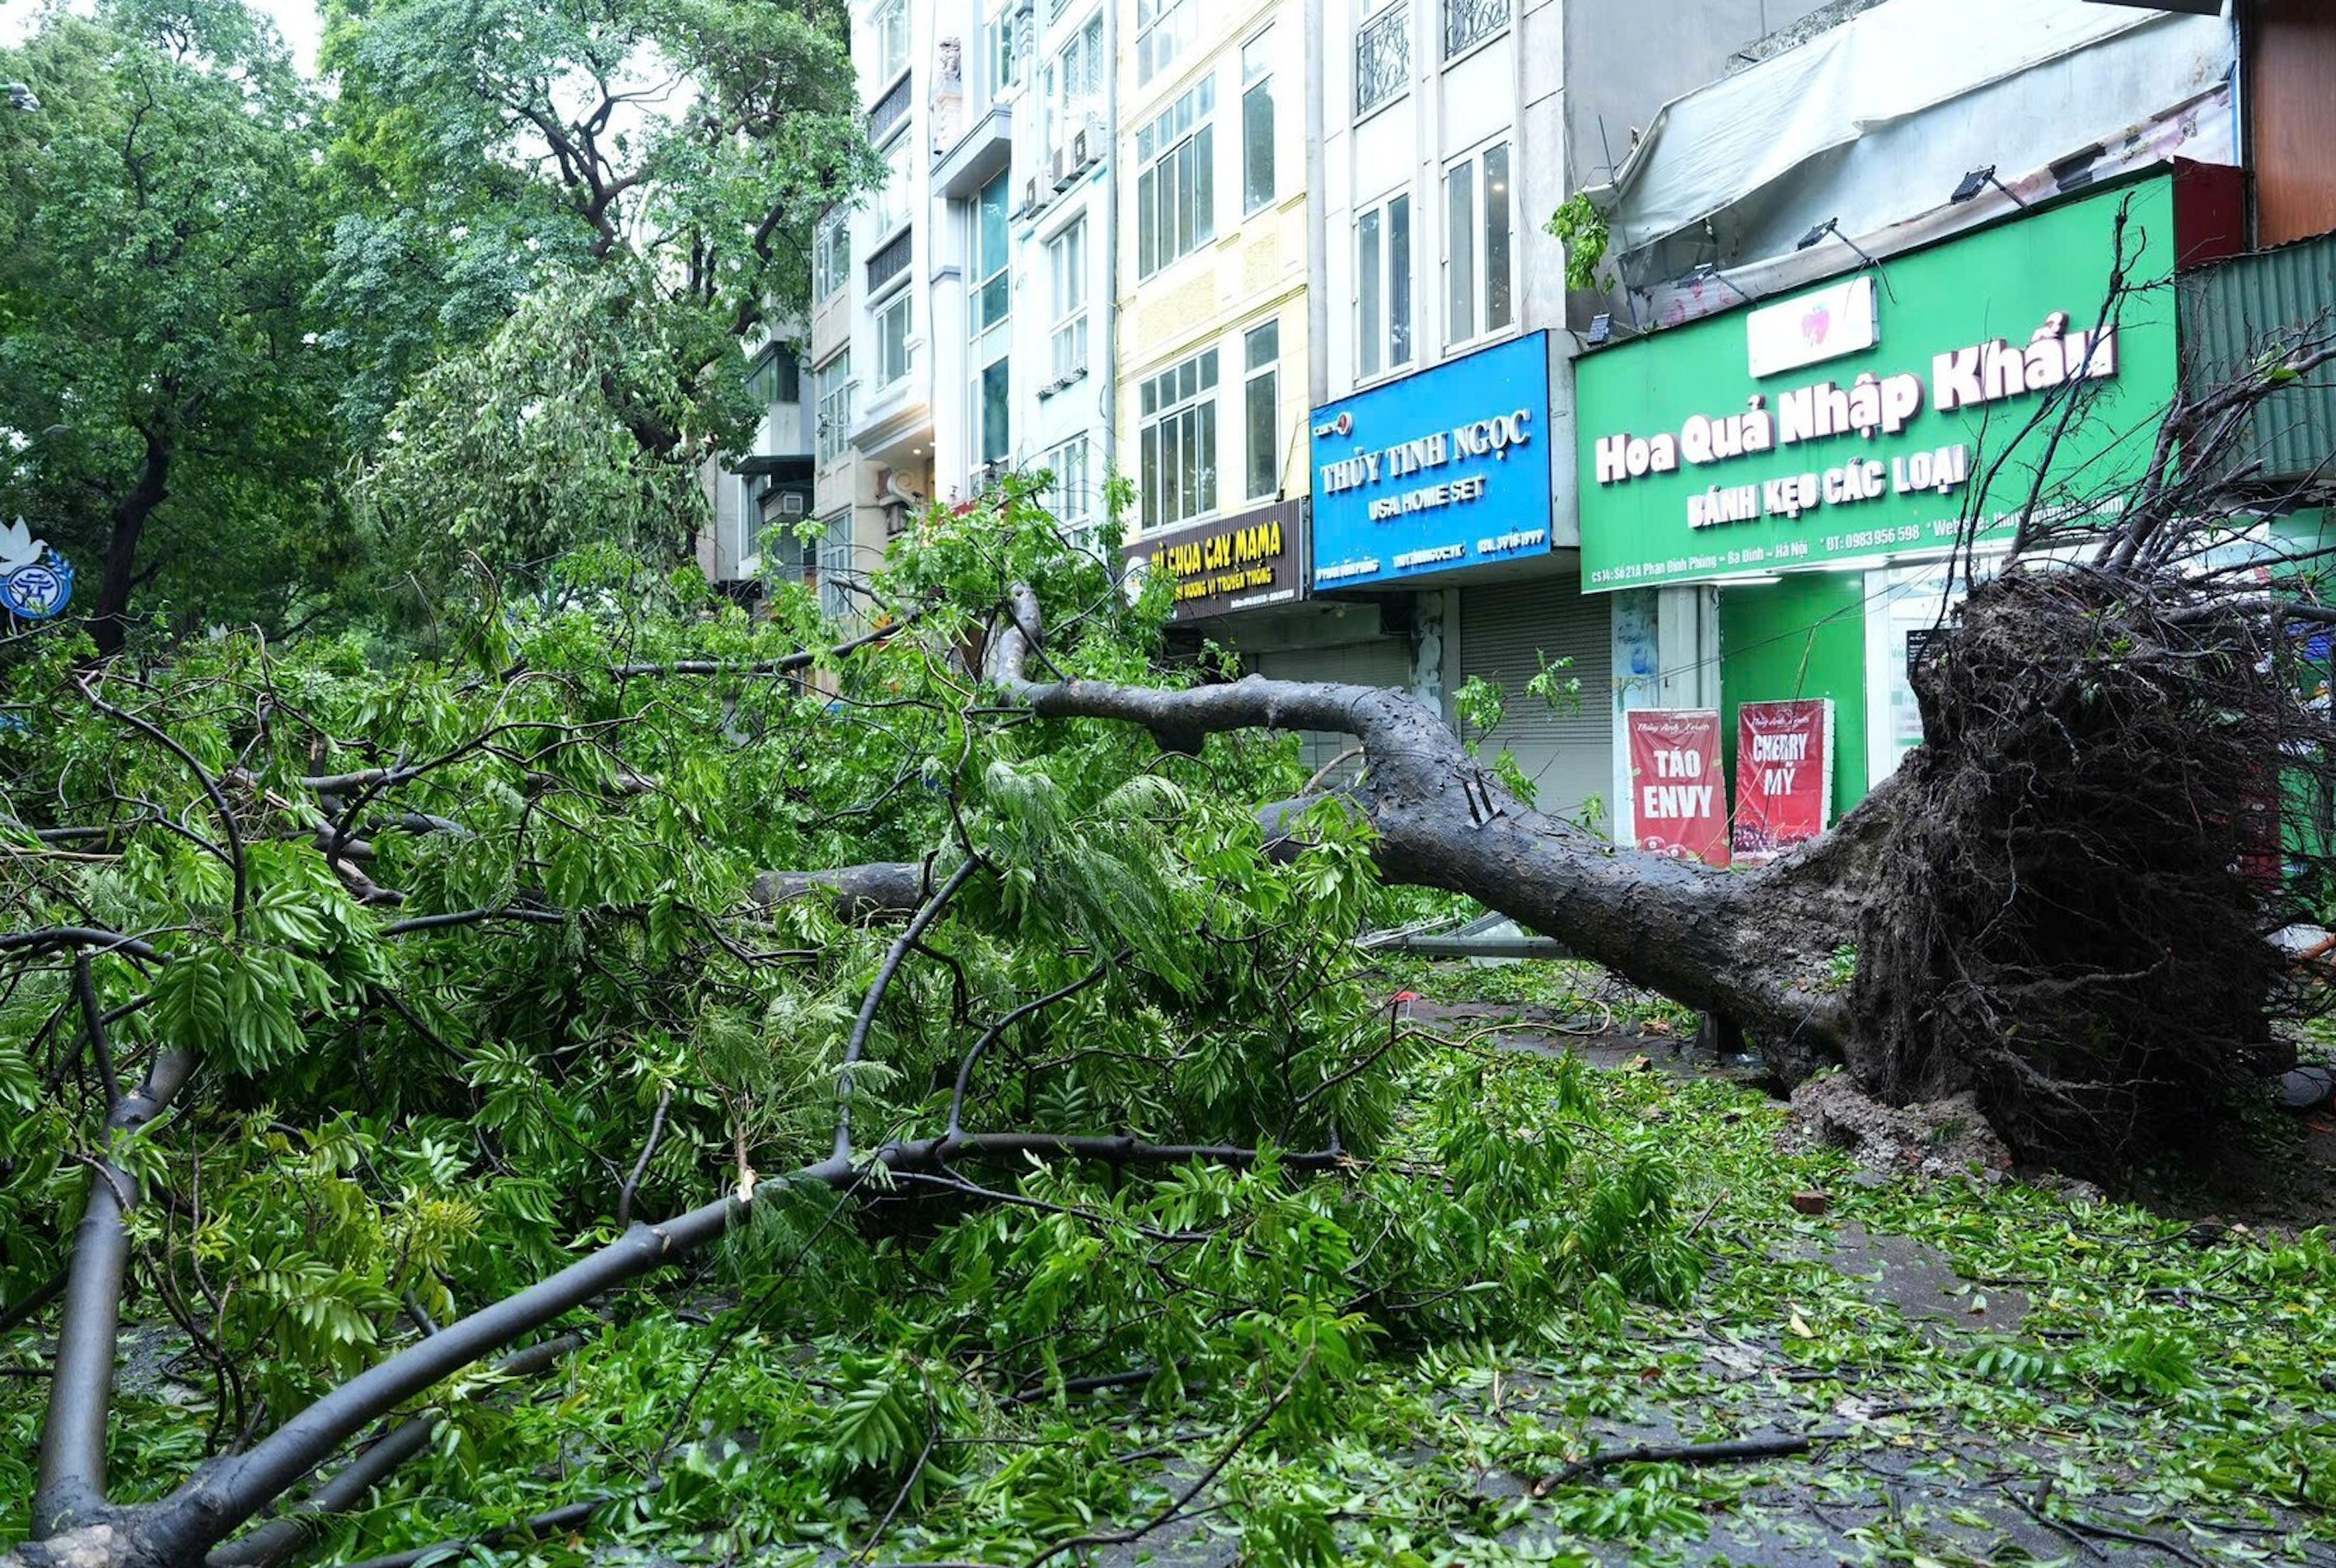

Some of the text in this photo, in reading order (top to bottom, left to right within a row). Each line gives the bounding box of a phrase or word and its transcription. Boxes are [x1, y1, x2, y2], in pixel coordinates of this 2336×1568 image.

[1595, 311, 2118, 484] Hoa Quả Nhập Khẩu
[1320, 409, 1532, 494] THỦY TINH NGỌC
[1368, 475, 1486, 521] USA HOME SET
[1687, 444, 1969, 528] BÁNH KẸO CÁC LOẠI
[1205, 532, 1232, 570] CAY
[1236, 521, 1281, 564] MAMA
[1643, 561, 1665, 576] Phan
[1727, 551, 1740, 565] Ba
[1775, 542, 1789, 558] Hà
[1791, 539, 1809, 560] Nội
[1846, 533, 1873, 549] 0983
[1874, 529, 1896, 545] 956
[1898, 524, 1920, 541] 598
[1653, 747, 1701, 778] TÁO
[1753, 733, 1808, 762] CHERRY
[1643, 785, 1713, 818] ENVY
[1763, 761, 1796, 796] MỸ
